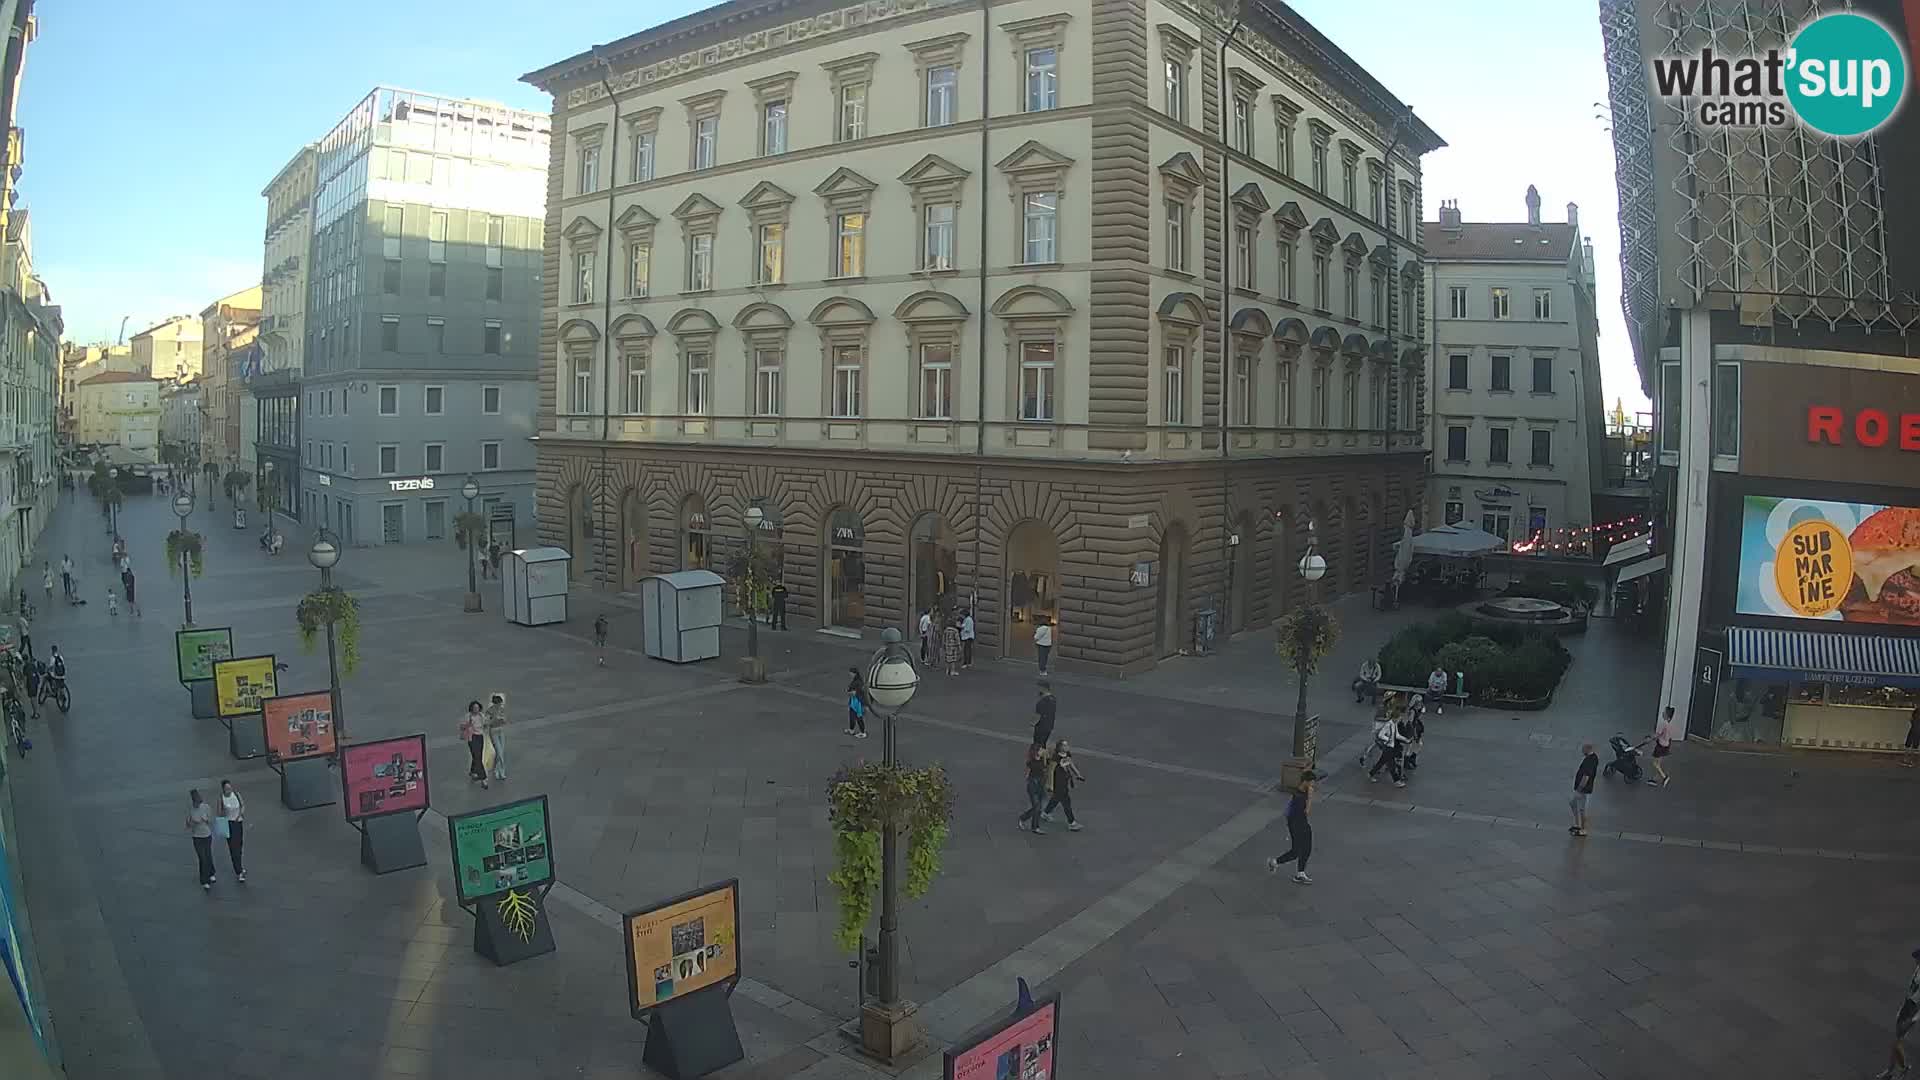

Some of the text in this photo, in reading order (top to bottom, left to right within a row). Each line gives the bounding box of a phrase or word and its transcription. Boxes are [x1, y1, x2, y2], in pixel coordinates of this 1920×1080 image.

[389, 476, 434, 491] TEZENIS
[1793, 531, 1831, 556] SUB
[1796, 553, 1833, 581] MAR
[1799, 577, 1834, 605] INE
